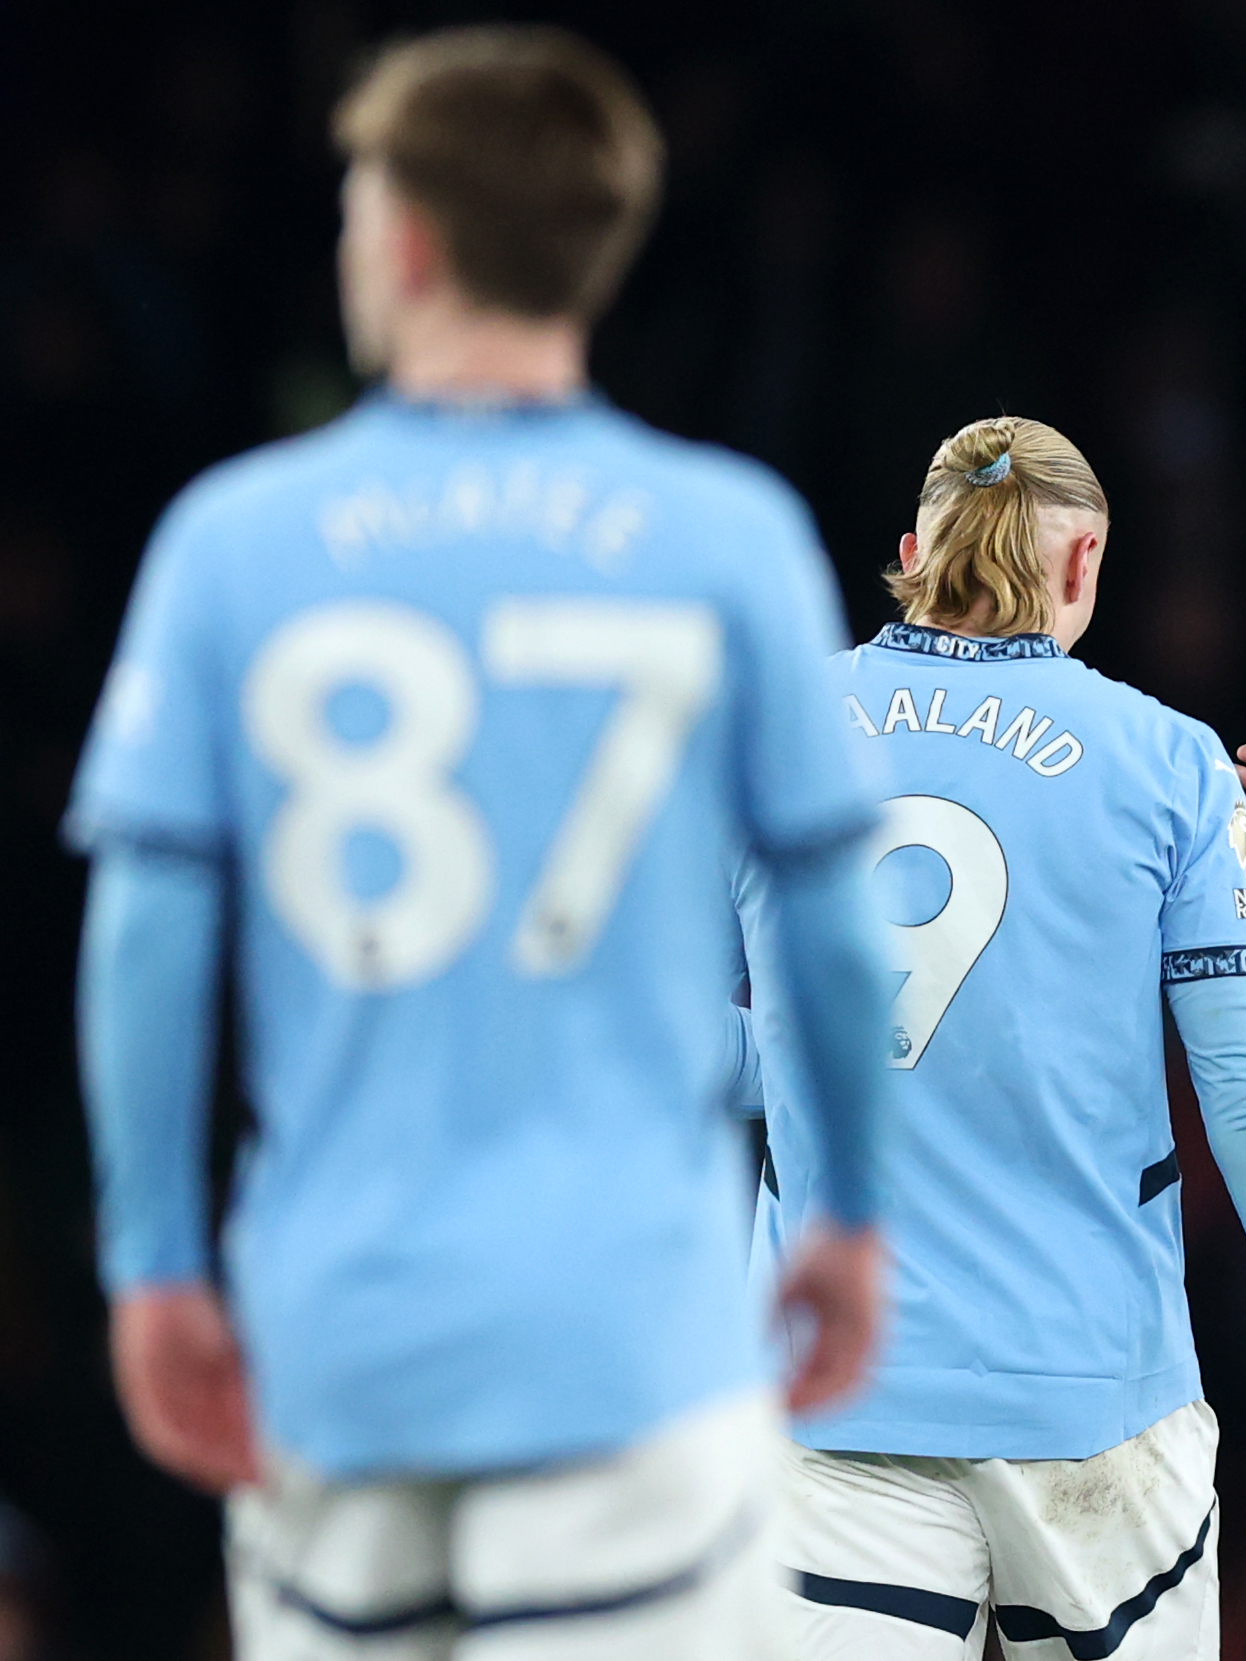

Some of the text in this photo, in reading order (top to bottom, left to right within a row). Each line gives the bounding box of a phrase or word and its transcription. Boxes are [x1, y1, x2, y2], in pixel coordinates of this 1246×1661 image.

[840, 687, 1084, 778] AALAND
[935, 635, 981, 659] CITY
[240, 597, 722, 992] 87
[872, 794, 1009, 1071] 9
